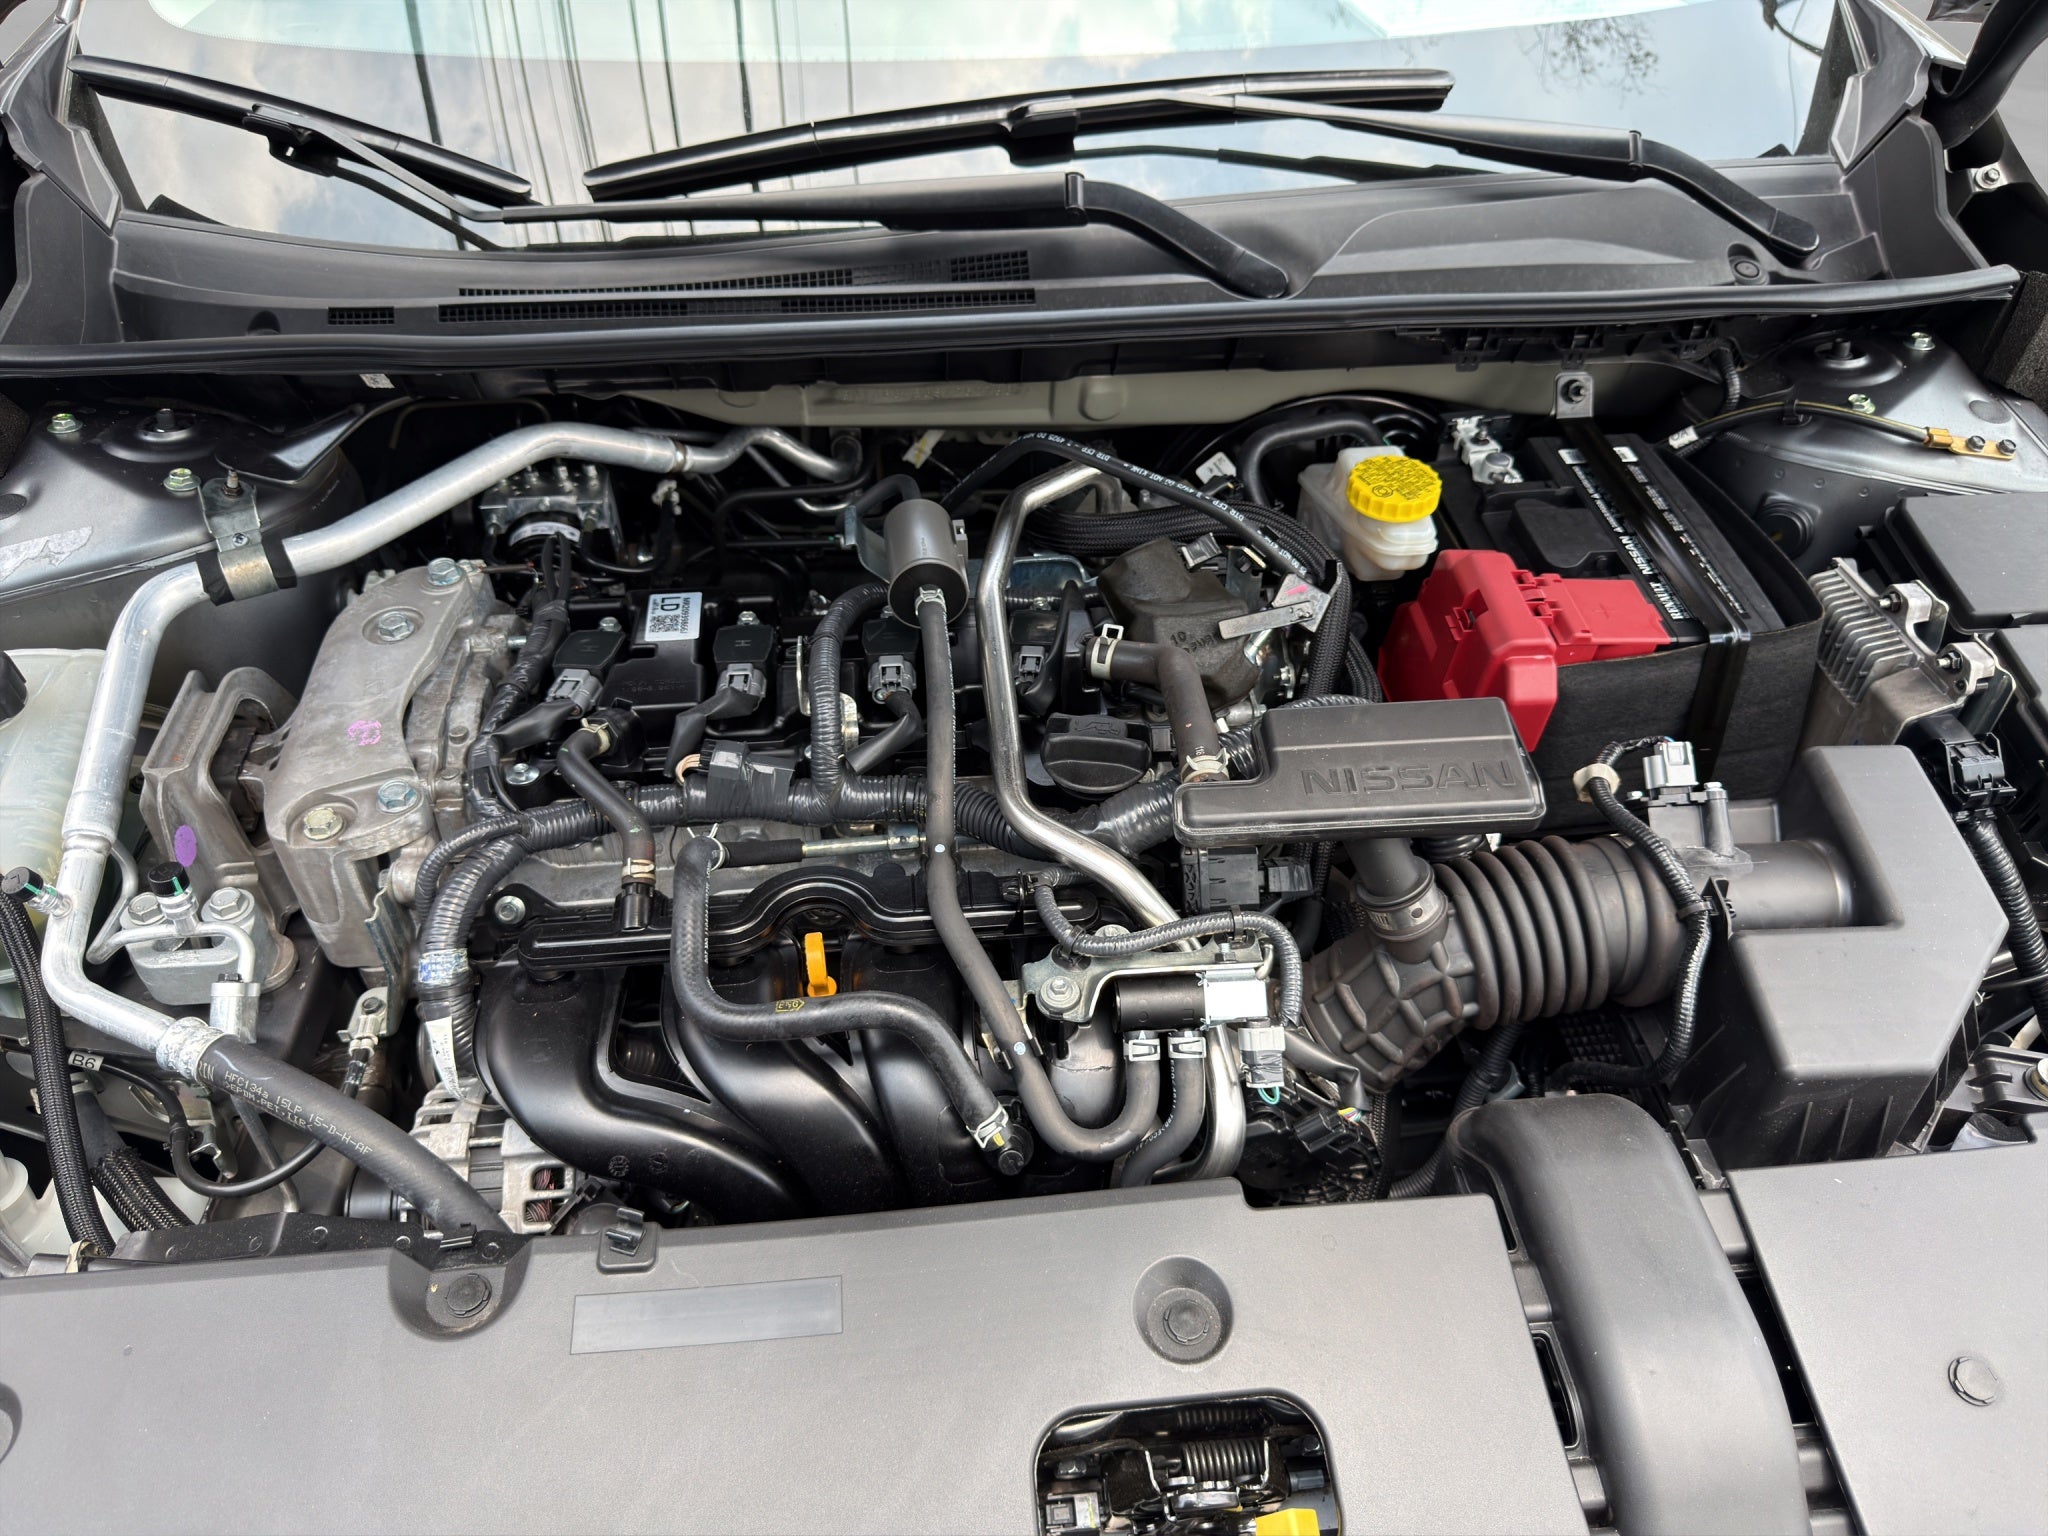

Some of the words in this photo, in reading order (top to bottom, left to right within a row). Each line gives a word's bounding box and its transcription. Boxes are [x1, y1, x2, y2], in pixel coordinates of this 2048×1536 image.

[1130, 465, 1148, 477] KINK
[1149, 473, 1165, 483] NOT
[1212, 500, 1228, 511] CFP
[1229, 508, 1245, 522] DTR
[1279, 549, 1292, 560] NOT
[1619, 535, 1654, 575] NISSAN
[661, 597, 681, 611] LD
[1649, 582, 1684, 620] RENAULT
[1301, 760, 1516, 795] NISSAN
[72, 1053, 96, 1069] B6
[225, 1071, 269, 1100] HFC134a
[276, 1095, 303, 1114] 15LP
